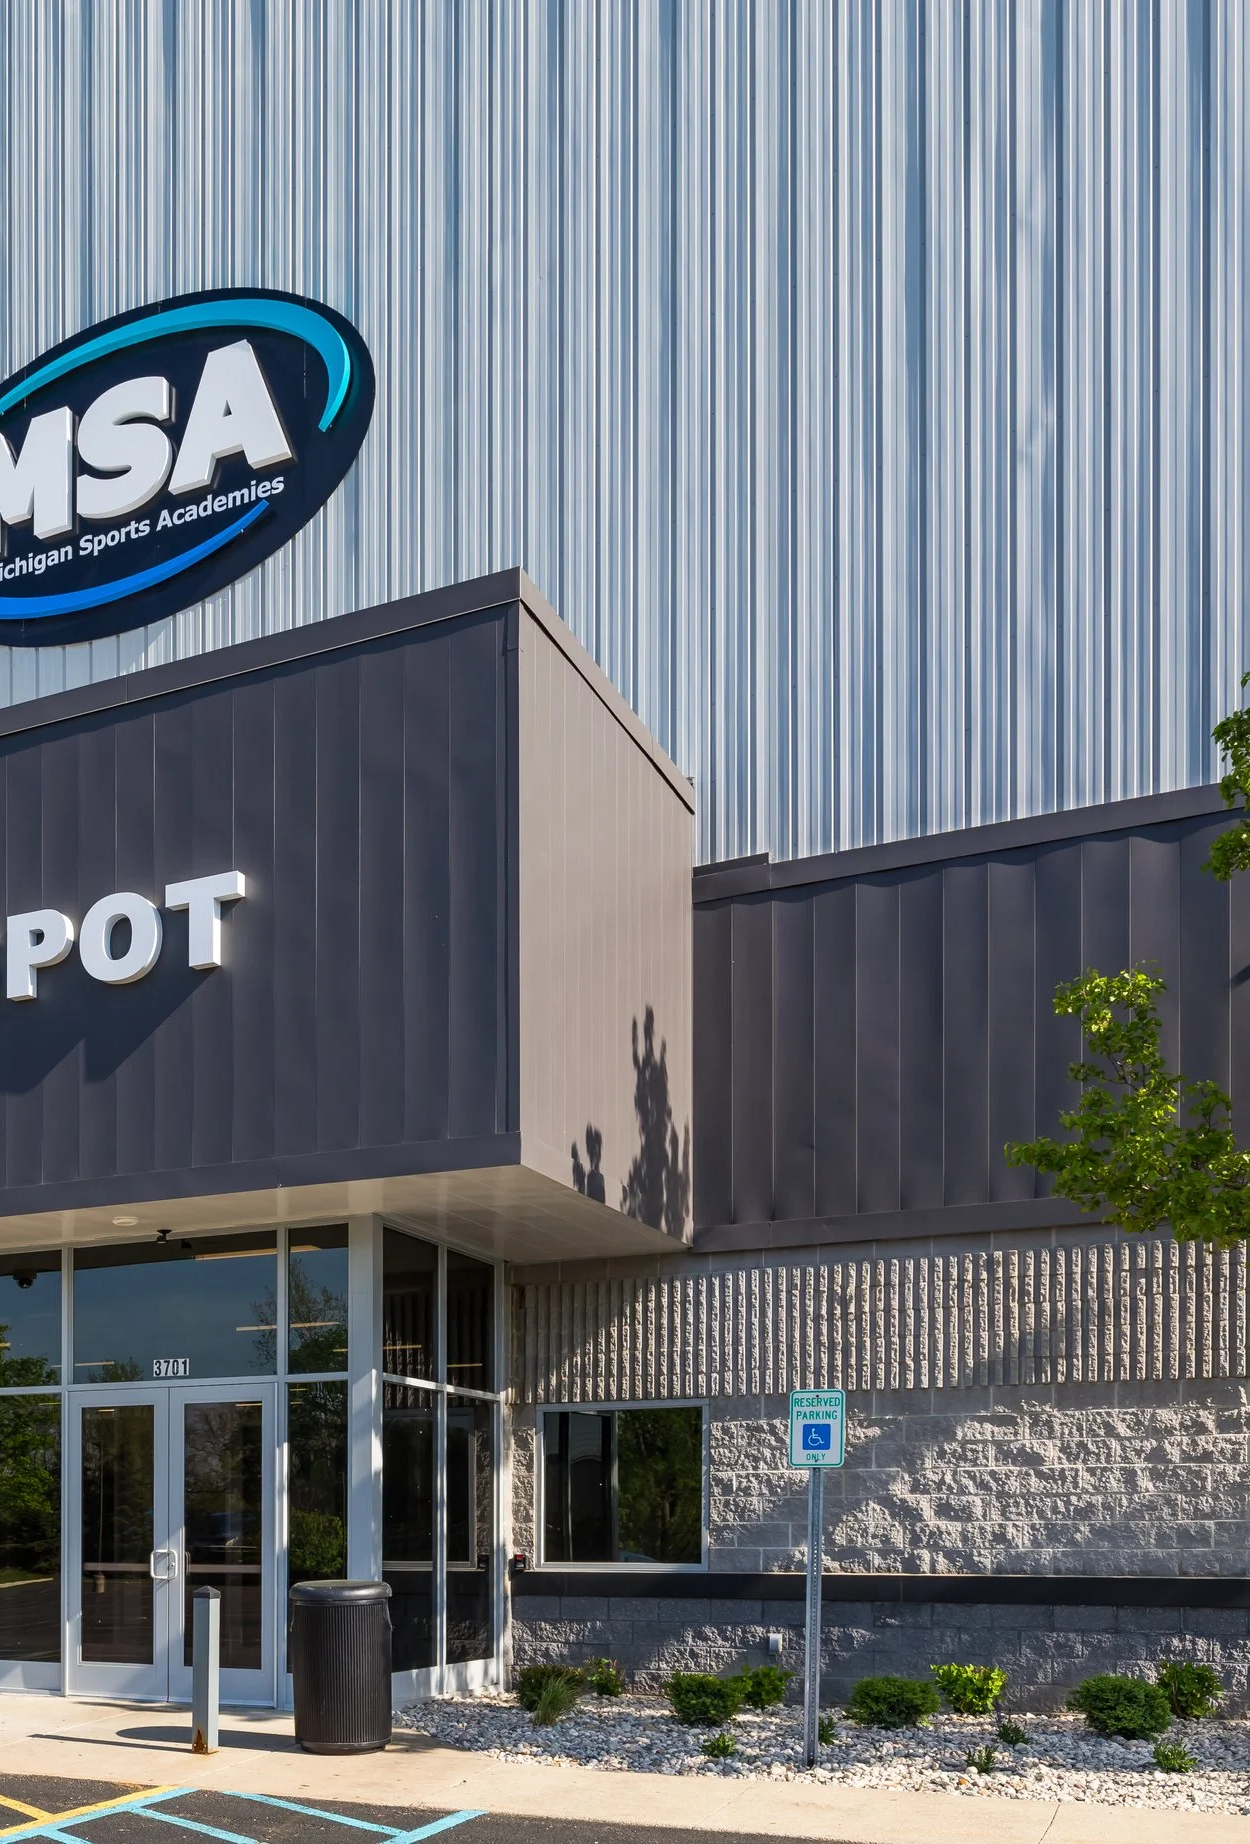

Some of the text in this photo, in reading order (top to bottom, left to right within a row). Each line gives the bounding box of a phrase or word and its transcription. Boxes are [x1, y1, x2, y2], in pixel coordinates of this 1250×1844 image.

[79, 518, 150, 557] Sports
[156, 476, 285, 532] Academies
[154, 1359, 188, 1376] 3701
[794, 1397, 841, 1407] RESERVED
[796, 1410, 838, 1420] PARKING
[806, 1453, 826, 1461] ONLY
